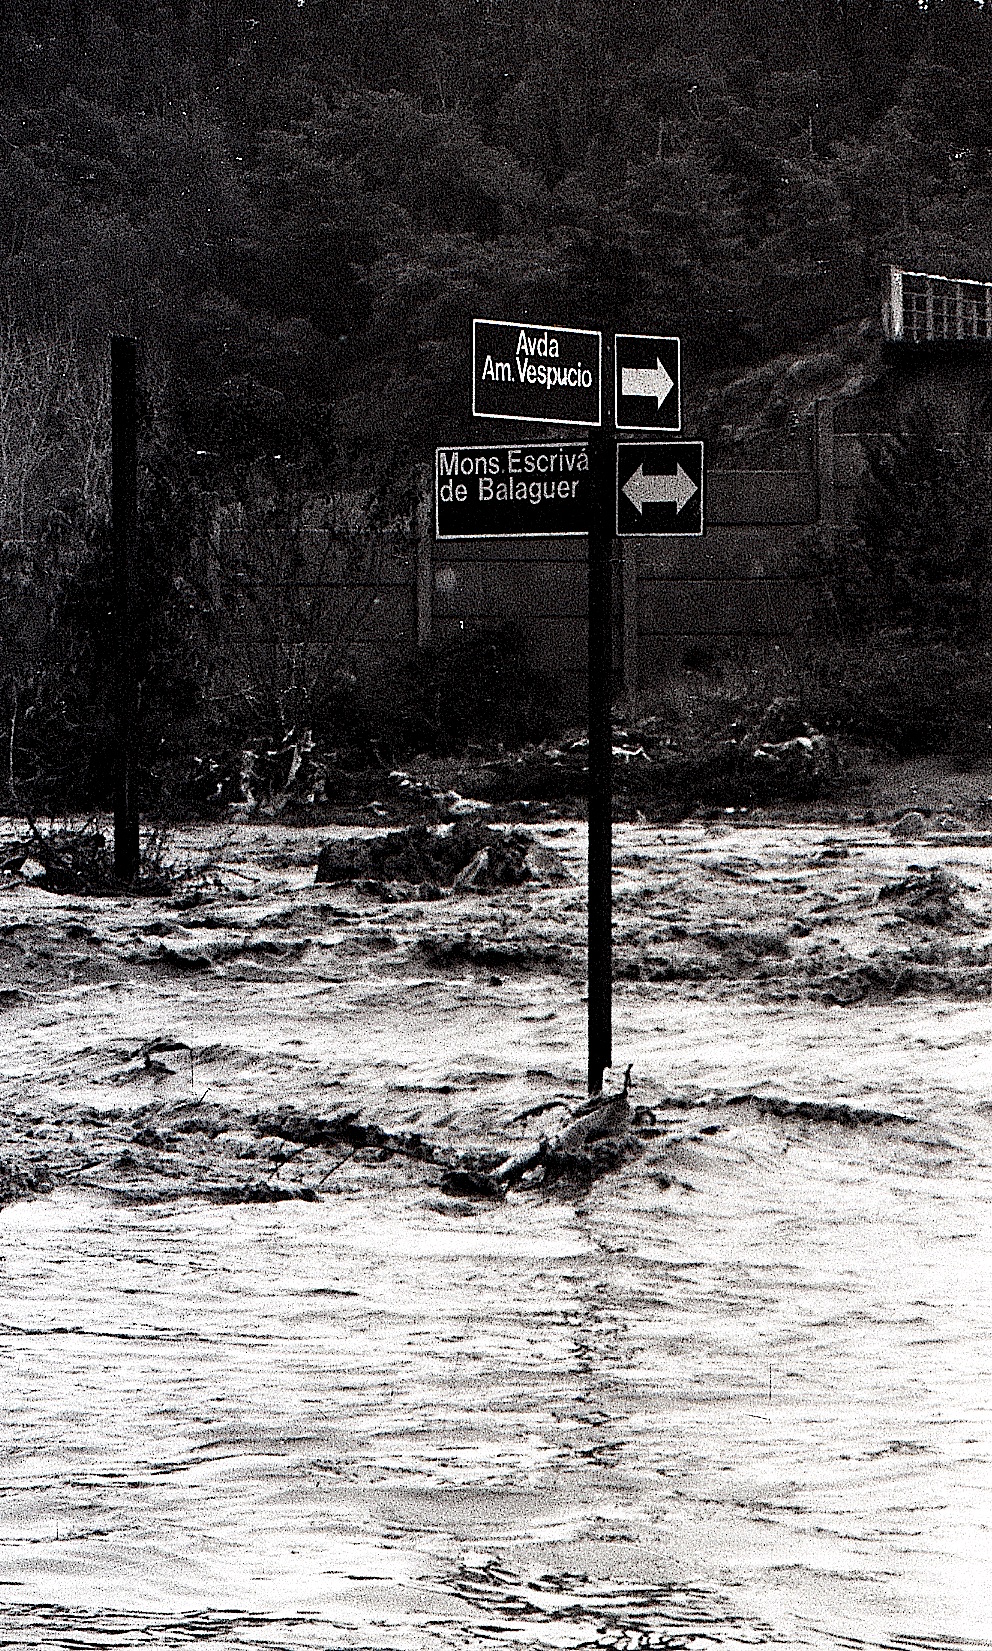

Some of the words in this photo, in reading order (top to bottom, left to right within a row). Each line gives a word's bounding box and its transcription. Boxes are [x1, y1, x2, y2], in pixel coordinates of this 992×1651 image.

[516, 329, 559, 358] Avda
[440, 479, 468, 502] de
[478, 477, 580, 505] Balaguer
